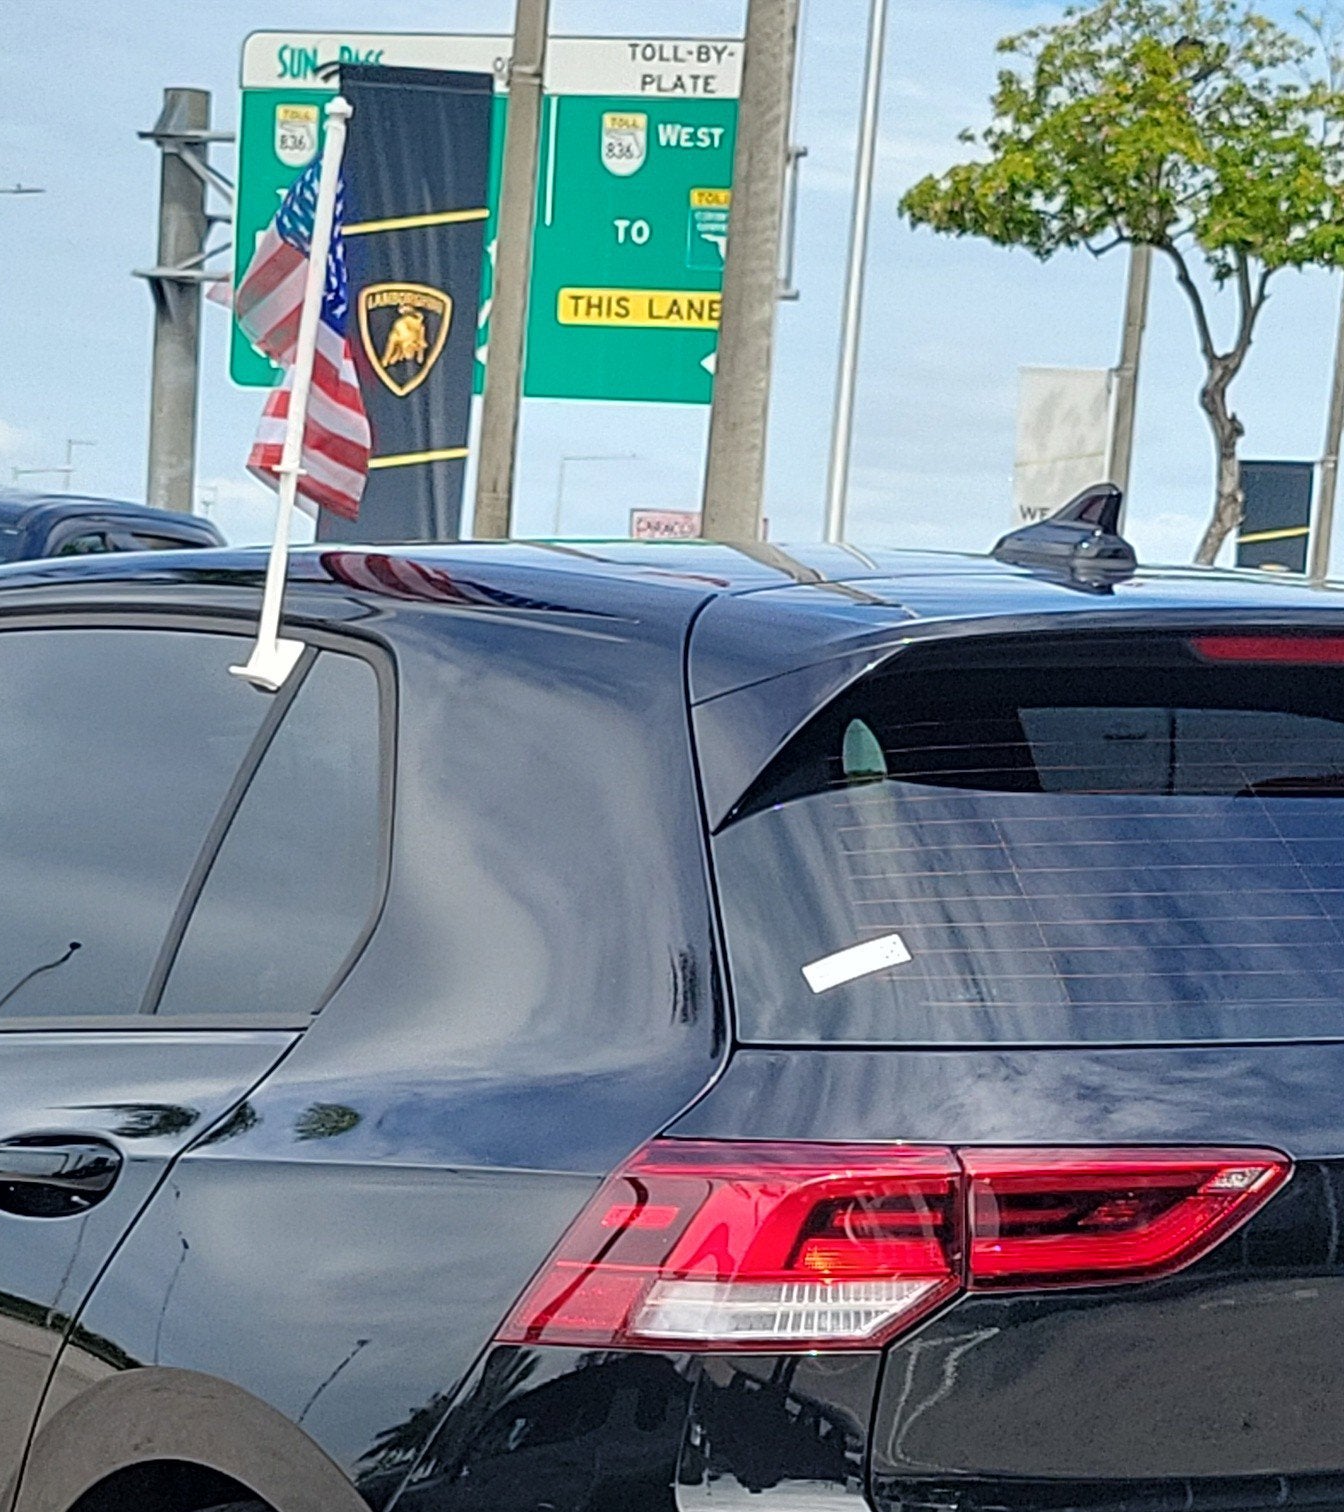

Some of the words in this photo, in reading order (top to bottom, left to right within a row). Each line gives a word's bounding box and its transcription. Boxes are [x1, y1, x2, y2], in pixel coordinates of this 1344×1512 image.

[628, 43, 736, 64] TOLL-BY-
[640, 74, 717, 94] PLATE
[609, 116, 641, 129] TOLL
[279, 134, 306, 151] 836
[605, 142, 634, 159] 836
[613, 218, 651, 245] TO
[568, 295, 631, 319] THIS
[647, 298, 722, 322] LANE
